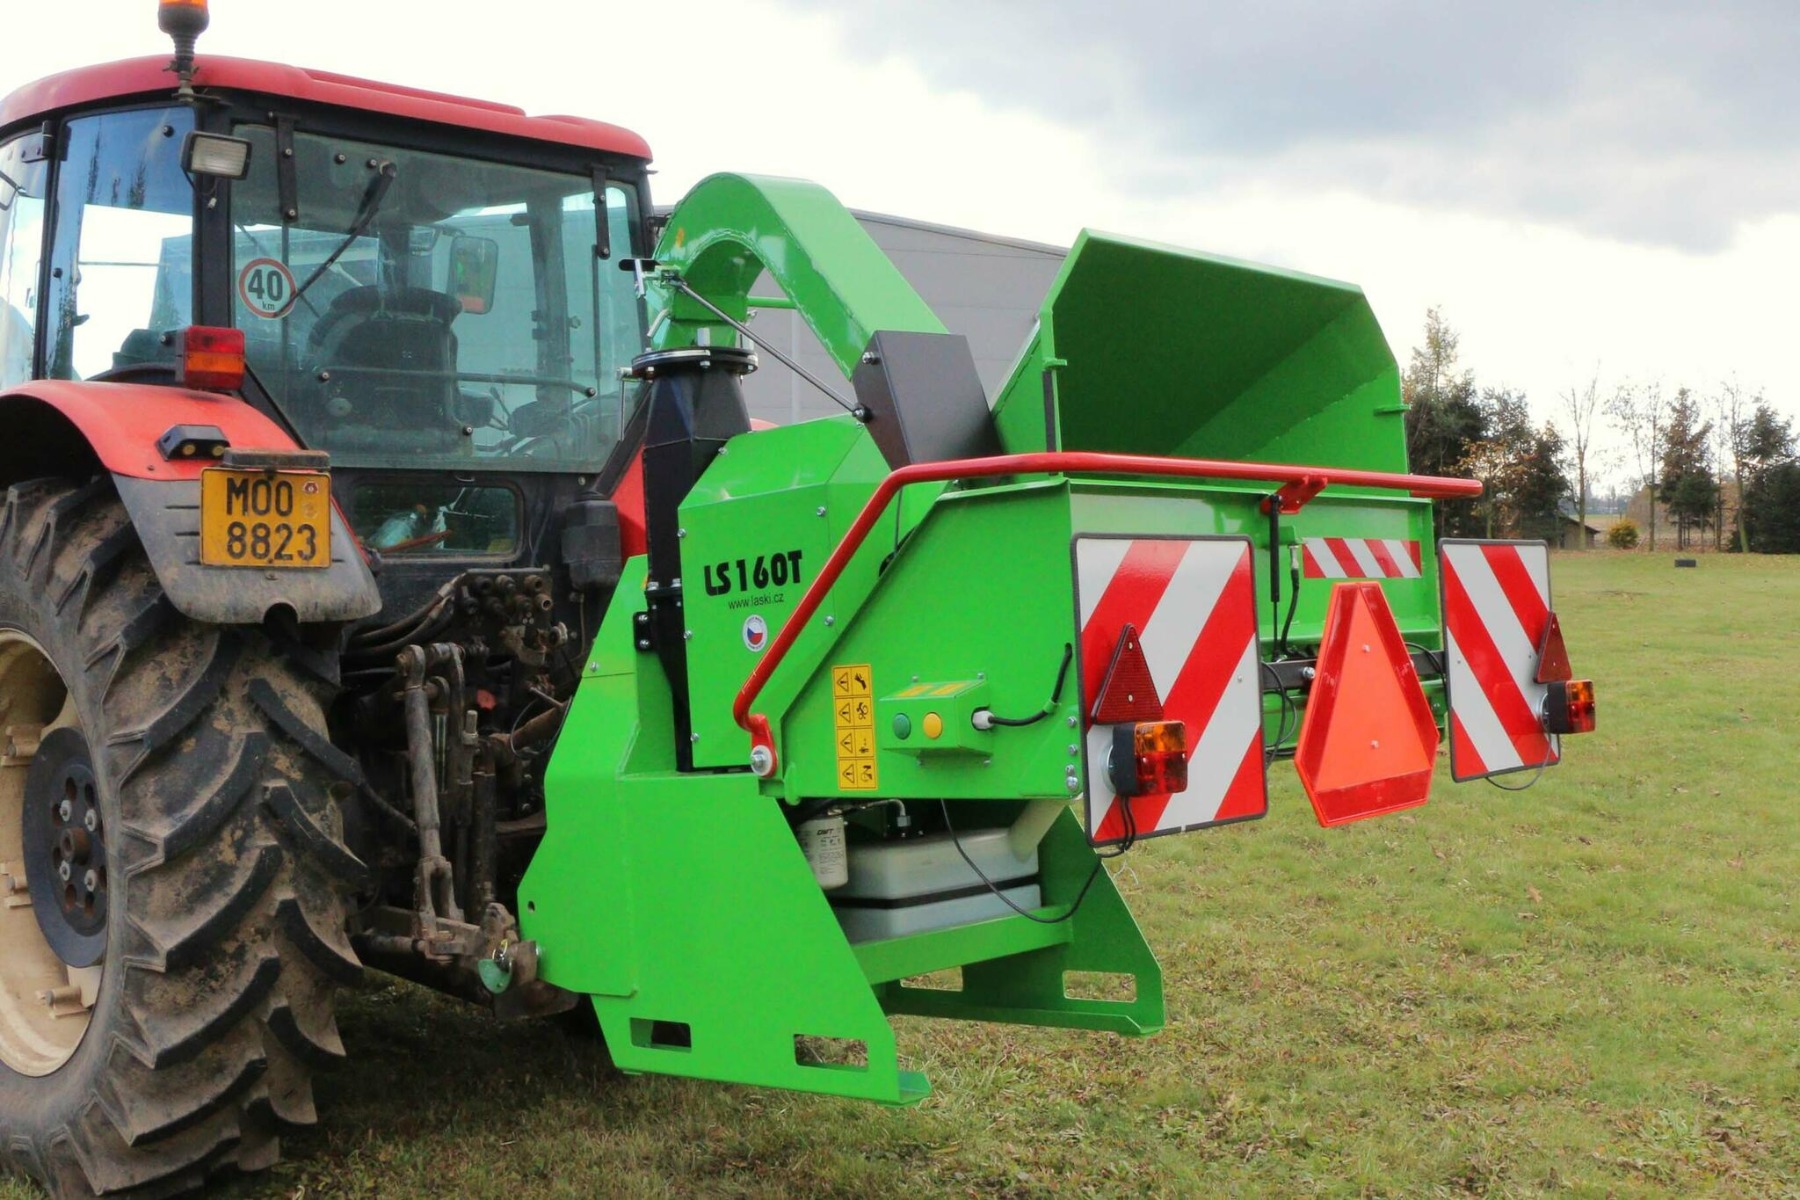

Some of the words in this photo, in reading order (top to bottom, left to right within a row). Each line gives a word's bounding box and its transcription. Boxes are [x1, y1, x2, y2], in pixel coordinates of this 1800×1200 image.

[248, 269, 283, 301] 40
[262, 301, 275, 310] km
[227, 521, 316, 561] 8823
[728, 593, 784, 610] www.laski.cz
